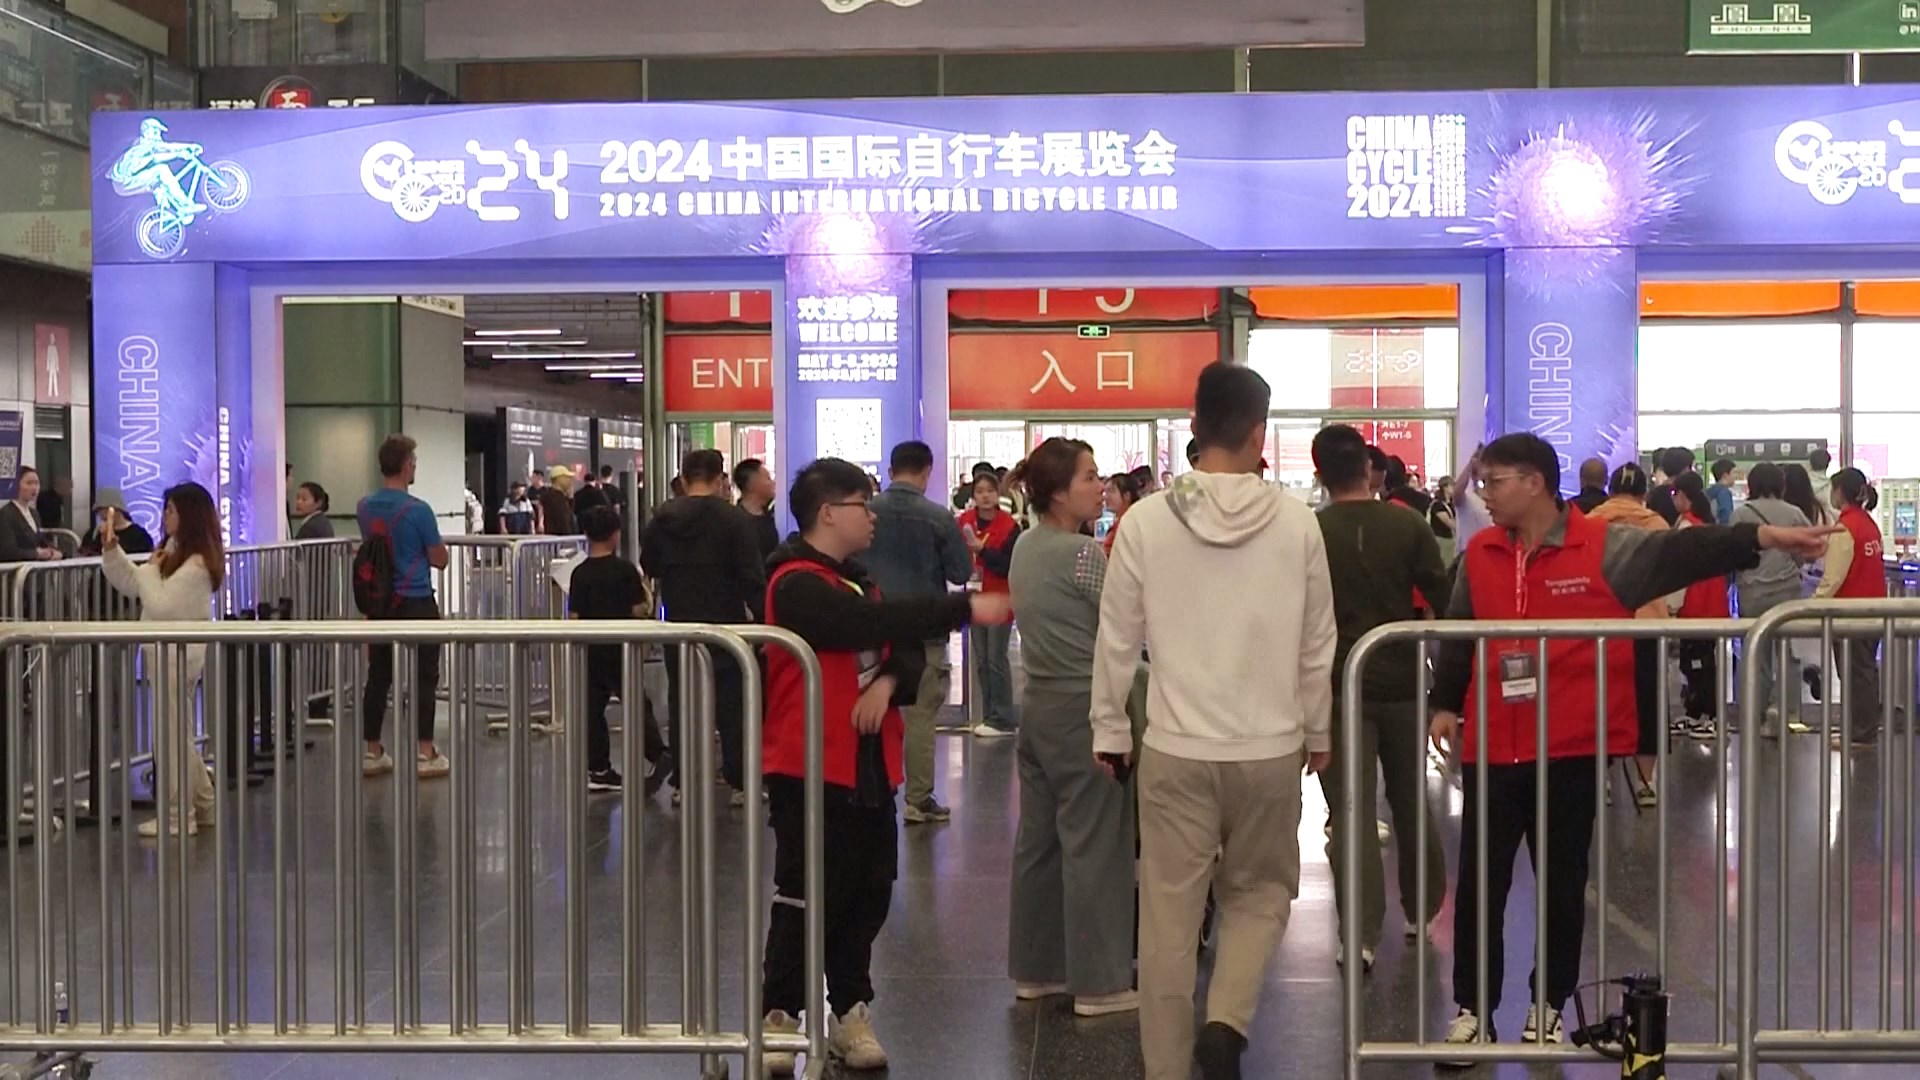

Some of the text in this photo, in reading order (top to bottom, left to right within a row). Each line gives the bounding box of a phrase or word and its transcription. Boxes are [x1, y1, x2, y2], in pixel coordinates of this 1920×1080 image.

[1346, 115, 1433, 150] CHINA
[600, 129, 1178, 184] 2024 中国国际自行车展览会
[1346, 150, 1433, 184] CYCLE
[600, 185, 1179, 217] 2024 CHINA INTERNATIONAL BICYCLE FAIR
[1346, 184, 1433, 218] 2024
[798, 321, 898, 342] WELCOME
[692, 358, 773, 388] ENT
[1030, 350, 1134, 393] 入口
[118, 335, 160, 490] CHINA
[219, 406, 231, 486] CHINA
